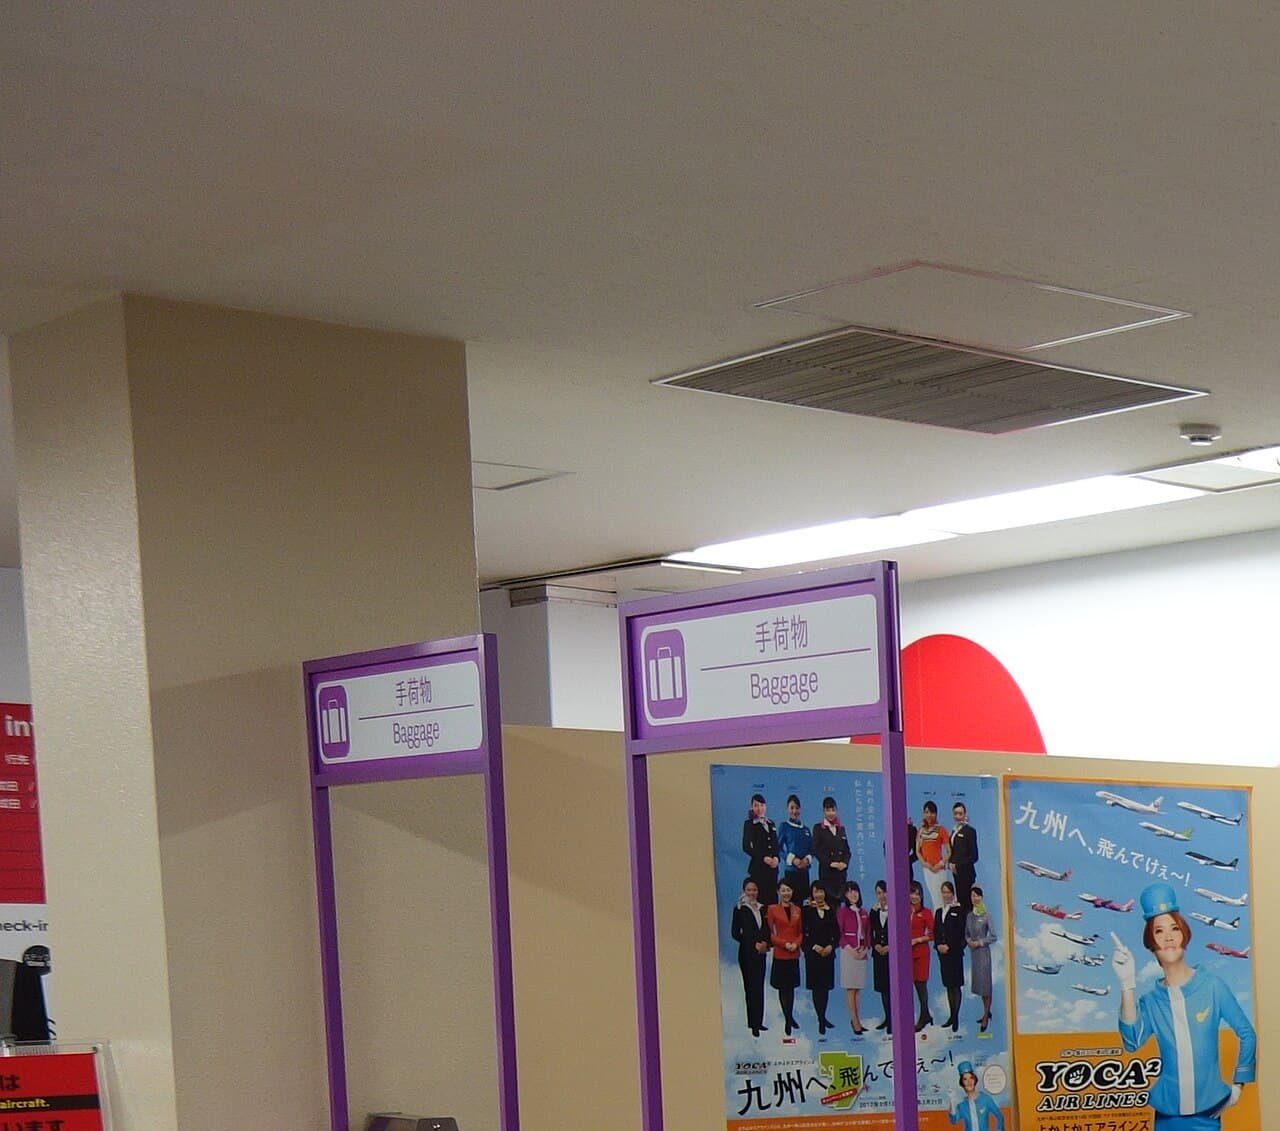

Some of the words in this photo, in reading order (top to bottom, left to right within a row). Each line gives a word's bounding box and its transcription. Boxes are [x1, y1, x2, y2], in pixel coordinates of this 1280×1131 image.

[755, 615, 808, 653] 手荷物
[395, 677, 432, 707] 手荷物
[750, 671, 818, 705] Baggage
[393, 722, 440, 748] Baggage
